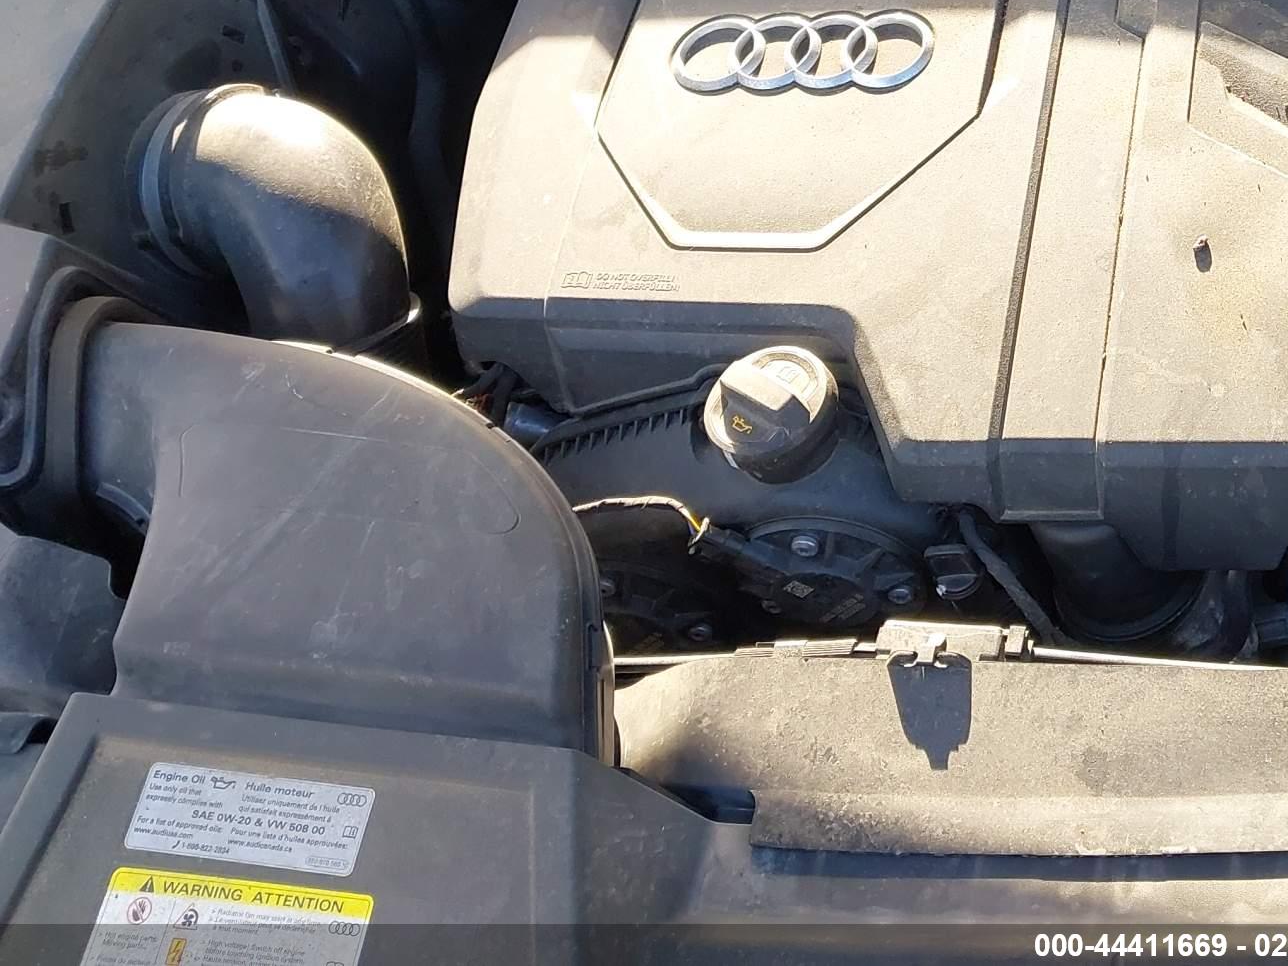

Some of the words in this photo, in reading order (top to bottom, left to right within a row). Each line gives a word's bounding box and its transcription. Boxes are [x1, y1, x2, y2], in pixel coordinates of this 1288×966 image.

[153, 770, 188, 782] Engine
[191, 775, 205, 784] Oil
[163, 785, 178, 794] only
[245, 782, 271, 793] Huile
[274, 788, 315, 799] moteur
[146, 794, 177, 803] expressly
[178, 798, 207, 808] complies
[208, 800, 223, 808] with
[267, 798, 309, 810] uniquement
[309, 803, 318, 811] de
[238, 805, 250, 813] qui
[251, 807, 278, 816] satisfait
[137, 815, 148, 823] For
[156, 818, 166, 826] list
[167, 819, 176, 827] of
[175, 822, 208, 832] approved
[191, 810, 215, 821] SAE
[217, 813, 251, 826] 0W-20
[254, 818, 263, 827] &
[267, 819, 286, 830] VW
[289, 823, 309, 833] 508
[311, 826, 325, 836] 00
[231, 827, 247, 836] Pour
[248, 830, 261, 838] une
[262, 831, 277, 840] liste
[163, 881, 243, 901] WARNING
[251, 891, 344, 914] ATTENTION
